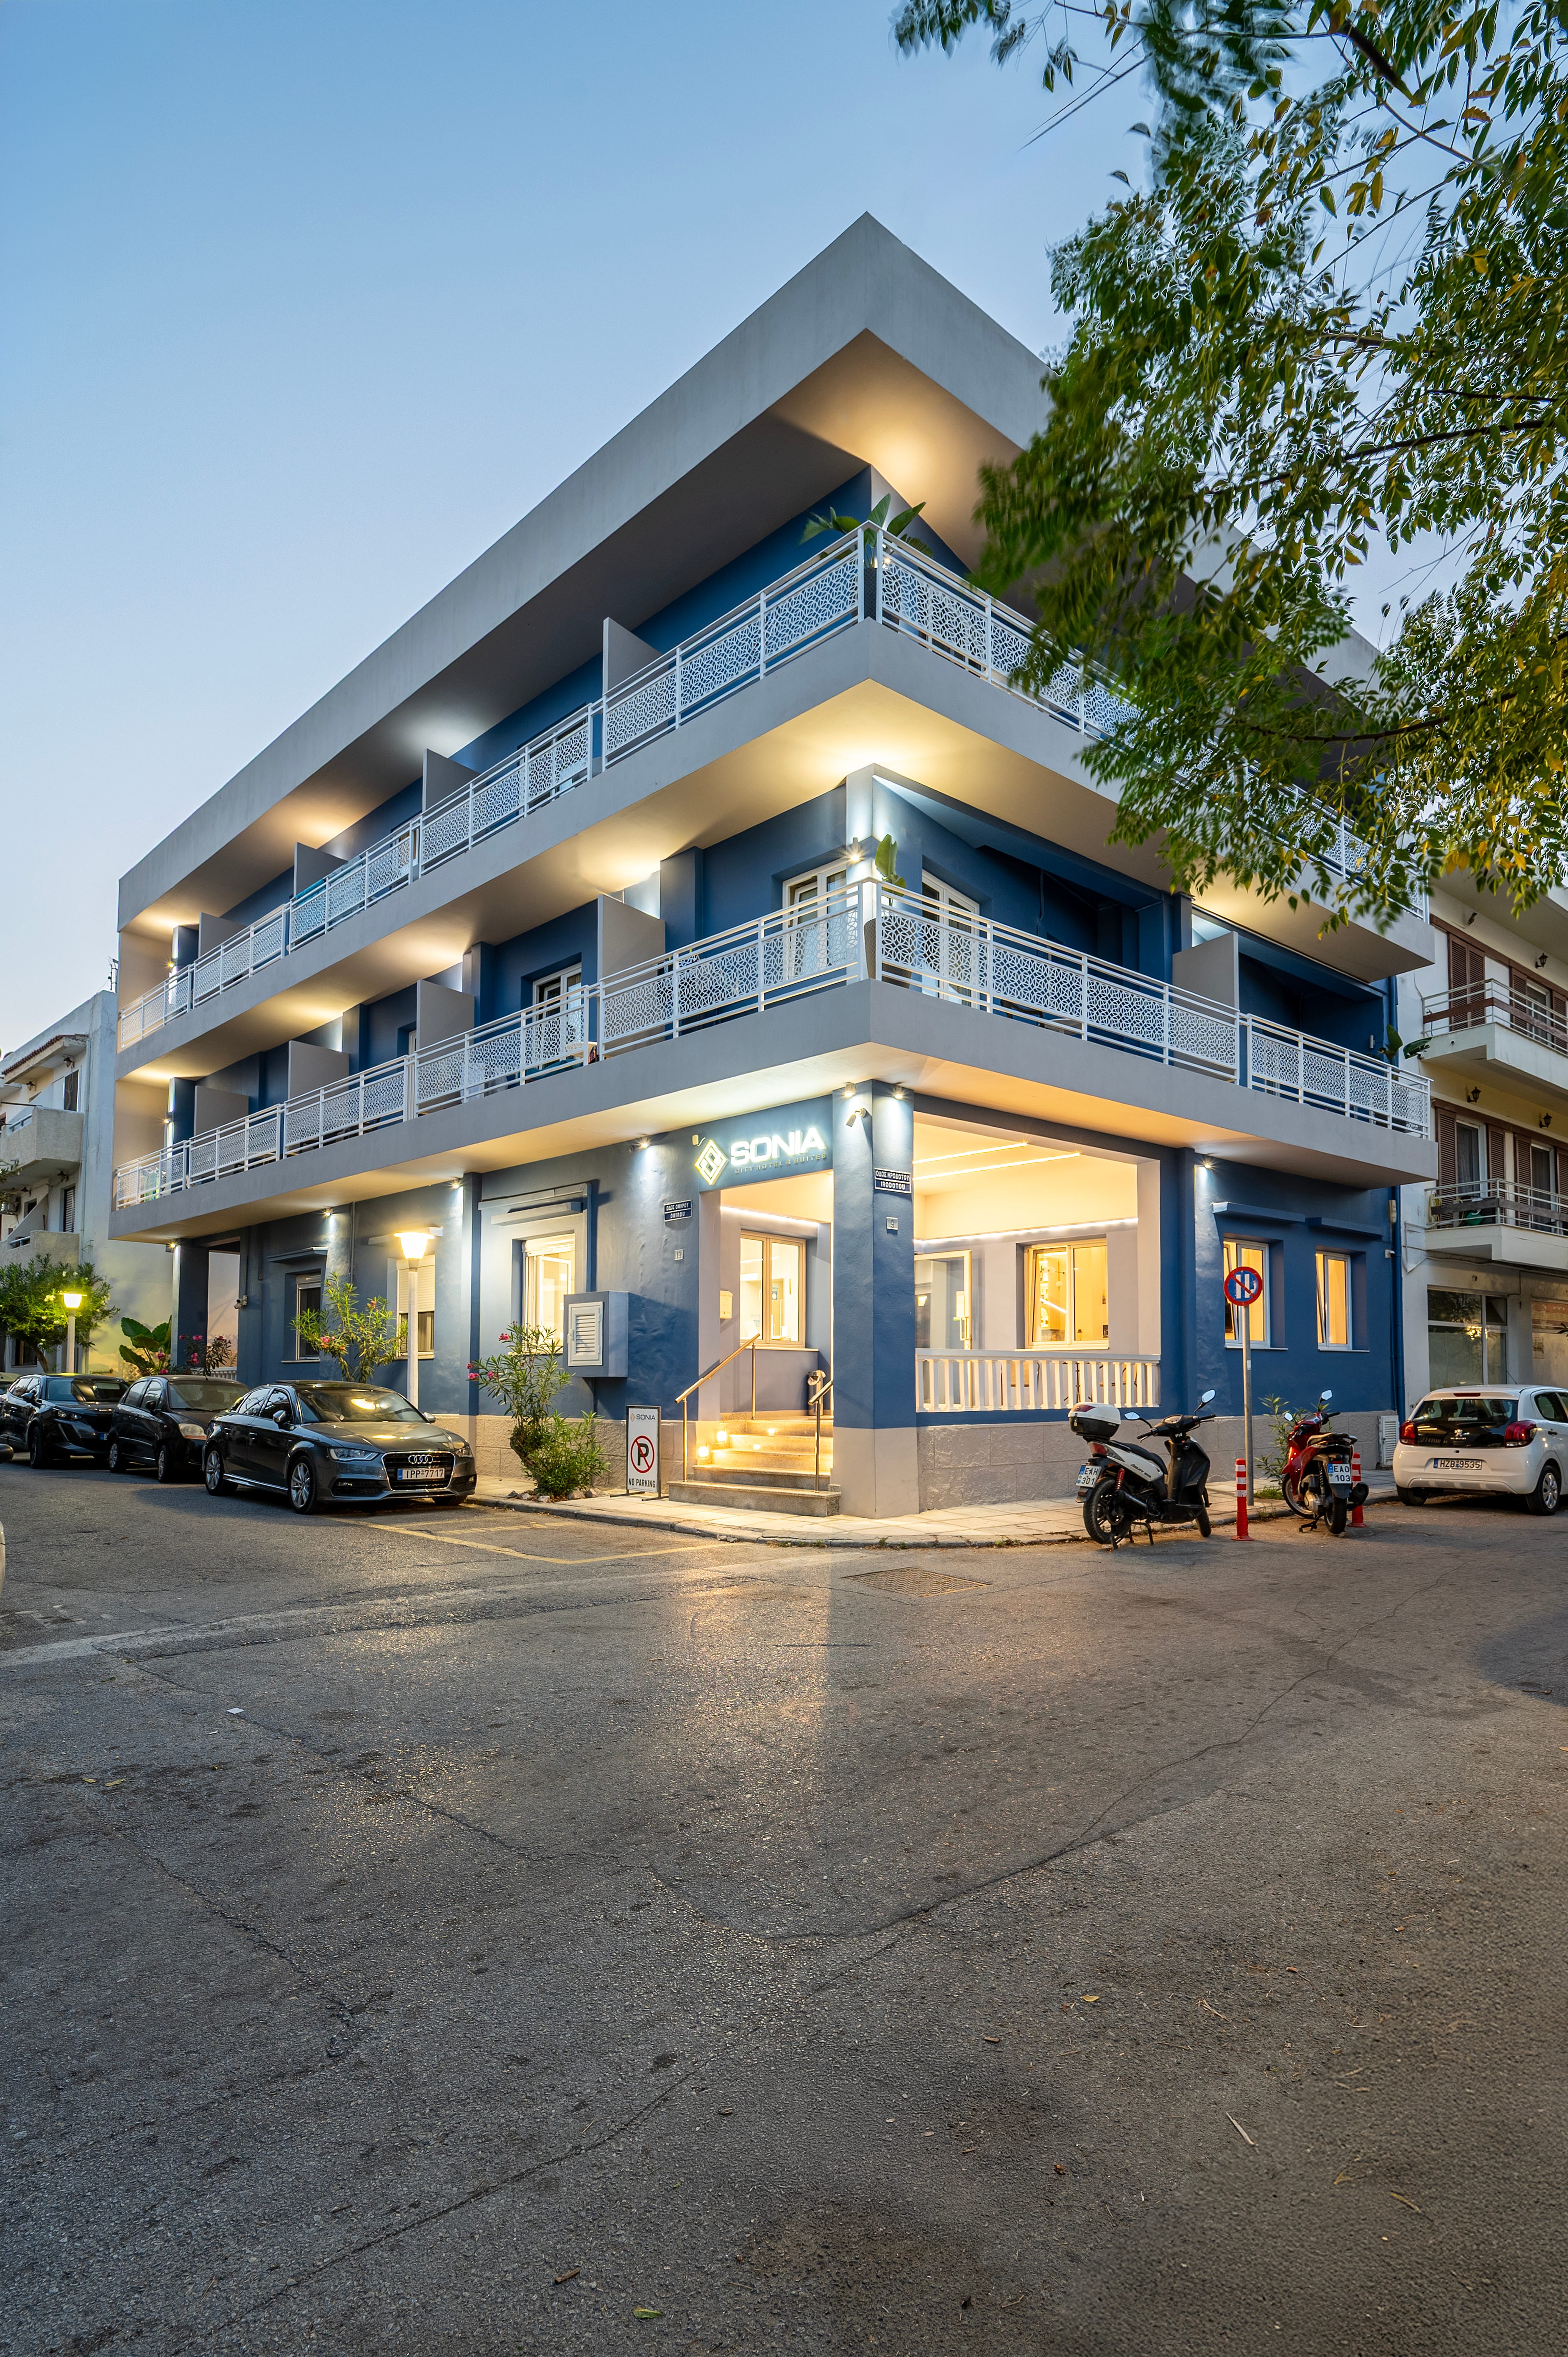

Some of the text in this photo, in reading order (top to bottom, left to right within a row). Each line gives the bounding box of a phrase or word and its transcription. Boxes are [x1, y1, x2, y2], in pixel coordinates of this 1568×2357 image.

[730, 1127, 826, 1166] SONIA
[735, 1166, 754, 1174] CITY
[756, 1161, 783, 1170] HOTEL
[794, 1153, 827, 1164] SUITES
[887, 1172, 910, 1181] ΗΡΟΔΟΤΟΥ
[880, 1181, 905, 1190] IRODOTOU
[890, 1220, 894, 1228] 9
[637, 1443, 649, 1466] P
[628, 1478, 656, 1488] NO PARKING
